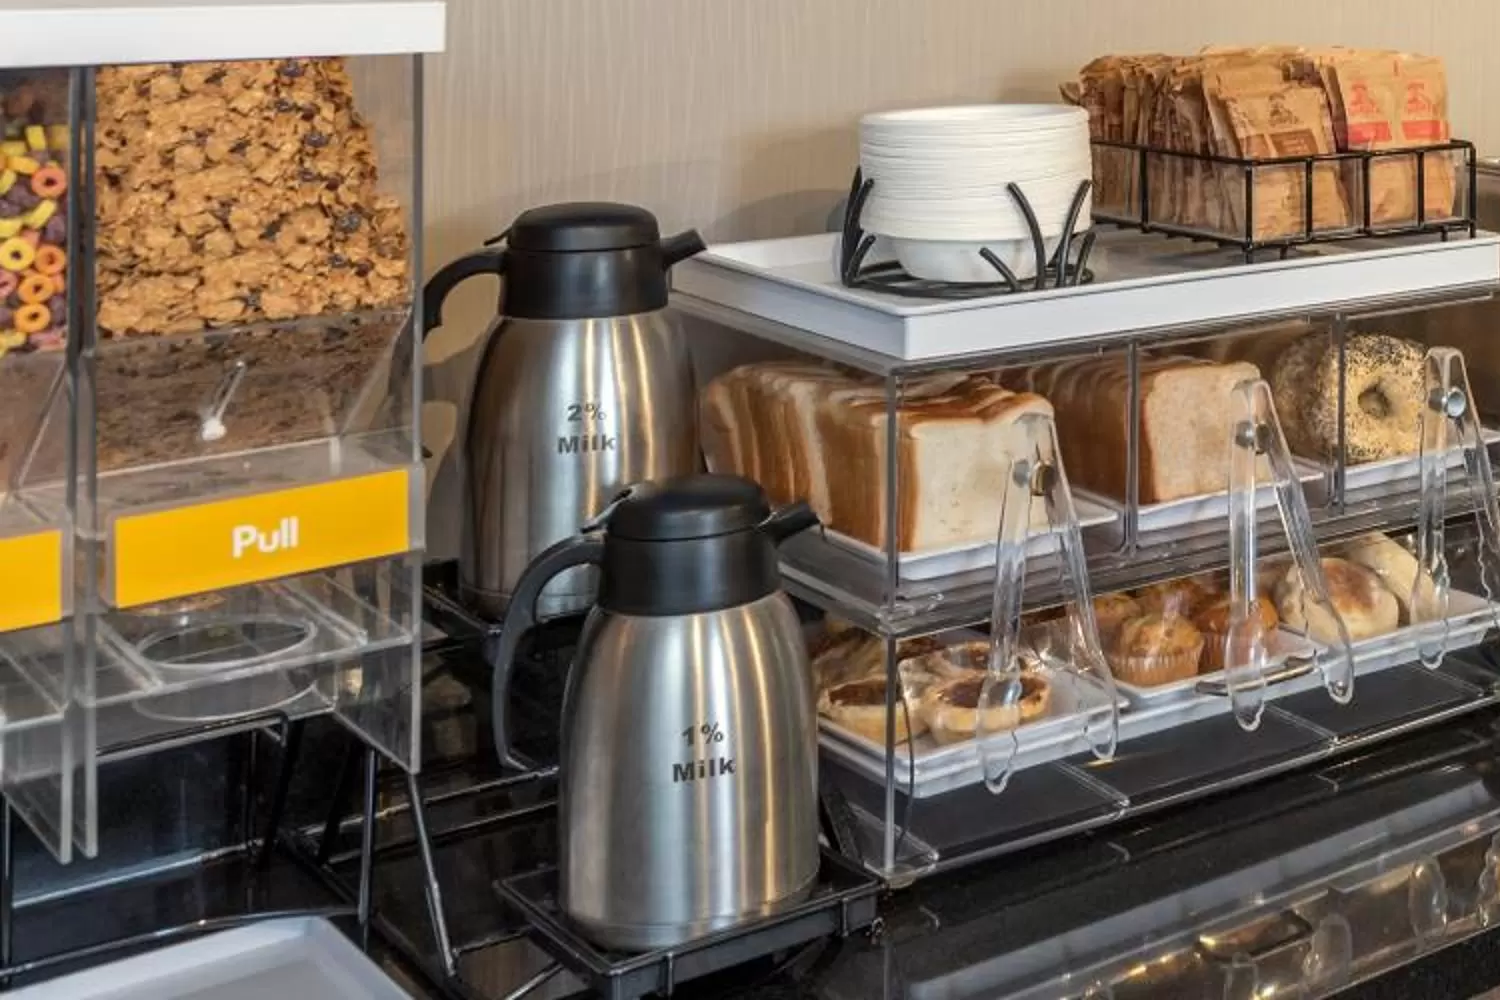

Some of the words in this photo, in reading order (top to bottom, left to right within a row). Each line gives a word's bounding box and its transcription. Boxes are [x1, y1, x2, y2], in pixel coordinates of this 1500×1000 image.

[566, 402, 607, 423] 2%
[557, 434, 616, 455] Milk
[232, 515, 299, 559] Pull
[682, 722, 724, 747] 1%
[672, 757, 736, 783] Milk
